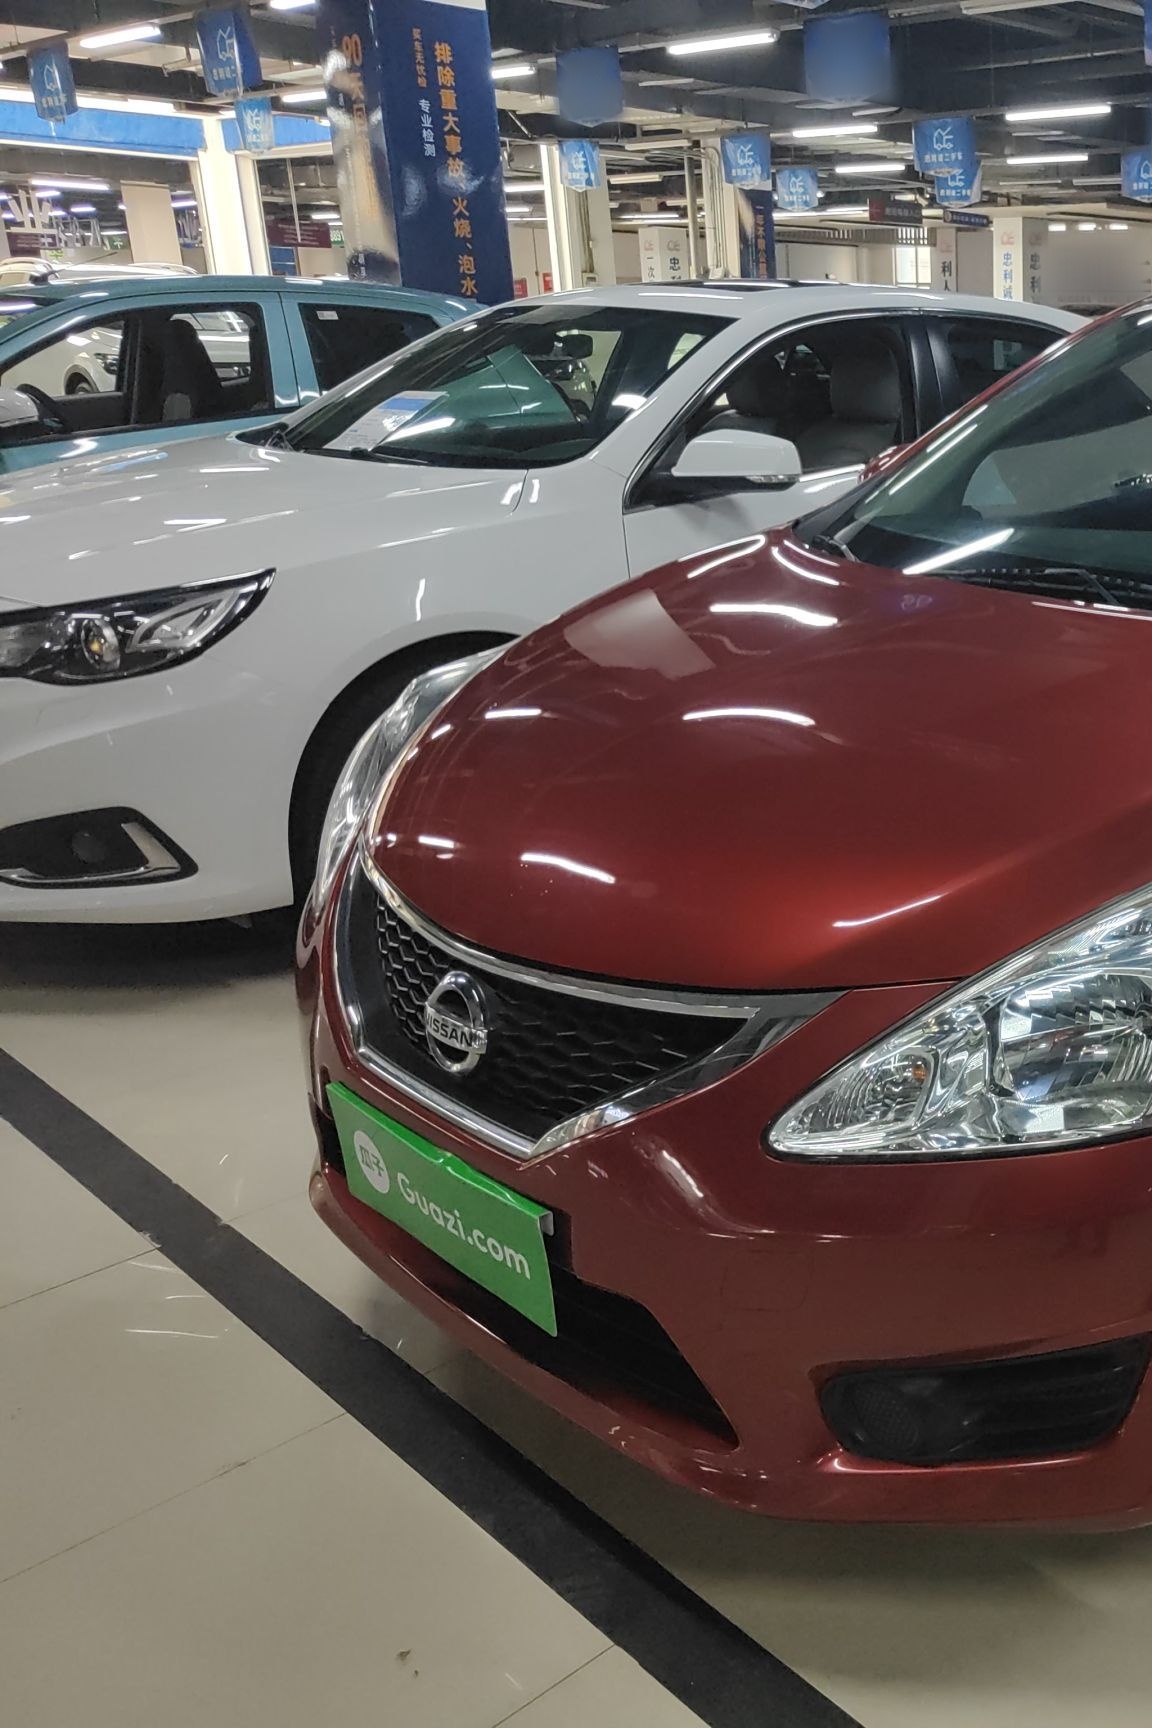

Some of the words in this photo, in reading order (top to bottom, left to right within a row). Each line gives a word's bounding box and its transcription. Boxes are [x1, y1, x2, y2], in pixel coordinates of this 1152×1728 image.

[419, 99, 436, 157] 专业检测
[434, 41, 479, 296] 排除重大事故、火烧、泡水
[425, 1010, 475, 1048] NISSAN
[396, 1171, 532, 1282] Guazi.com
